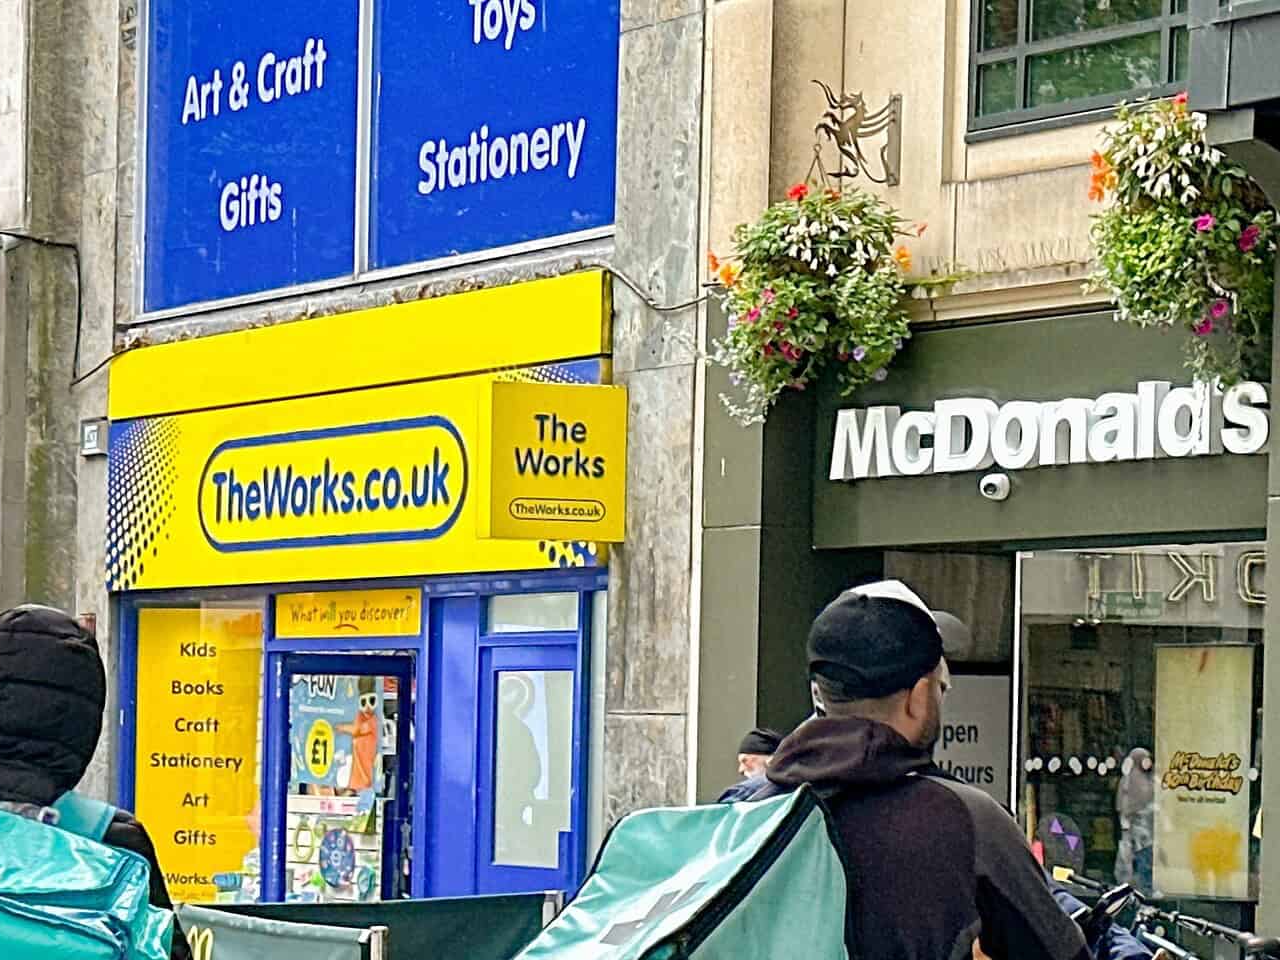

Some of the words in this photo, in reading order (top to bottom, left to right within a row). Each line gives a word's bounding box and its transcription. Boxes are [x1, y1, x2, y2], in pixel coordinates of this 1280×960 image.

[468, 0, 536, 50] Toys
[181, 75, 223, 125] Art
[228, 62, 250, 112] &
[256, 39, 328, 103] Craft
[418, 118, 587, 195] Stationery
[220, 174, 283, 232] Gifts
[534, 413, 587, 444] The
[829, 379, 1270, 481] McDonald's
[514, 447, 606, 480] Works
[212, 446, 450, 524] TheWorks.co.uk
[514, 503, 602, 518] TheWorks.co.uk
[290, 603, 317, 623] What
[338, 608, 357, 626] you
[180, 642, 217, 658] Kids
[171, 680, 224, 696] Books
[310, 674, 336, 698] FUN
[174, 717, 220, 733] Craft
[943, 725, 978, 749] pen
[149, 752, 243, 772] Stationery
[311, 738, 328, 766] £1
[182, 792, 209, 807] Art
[174, 830, 217, 846] Gifts
